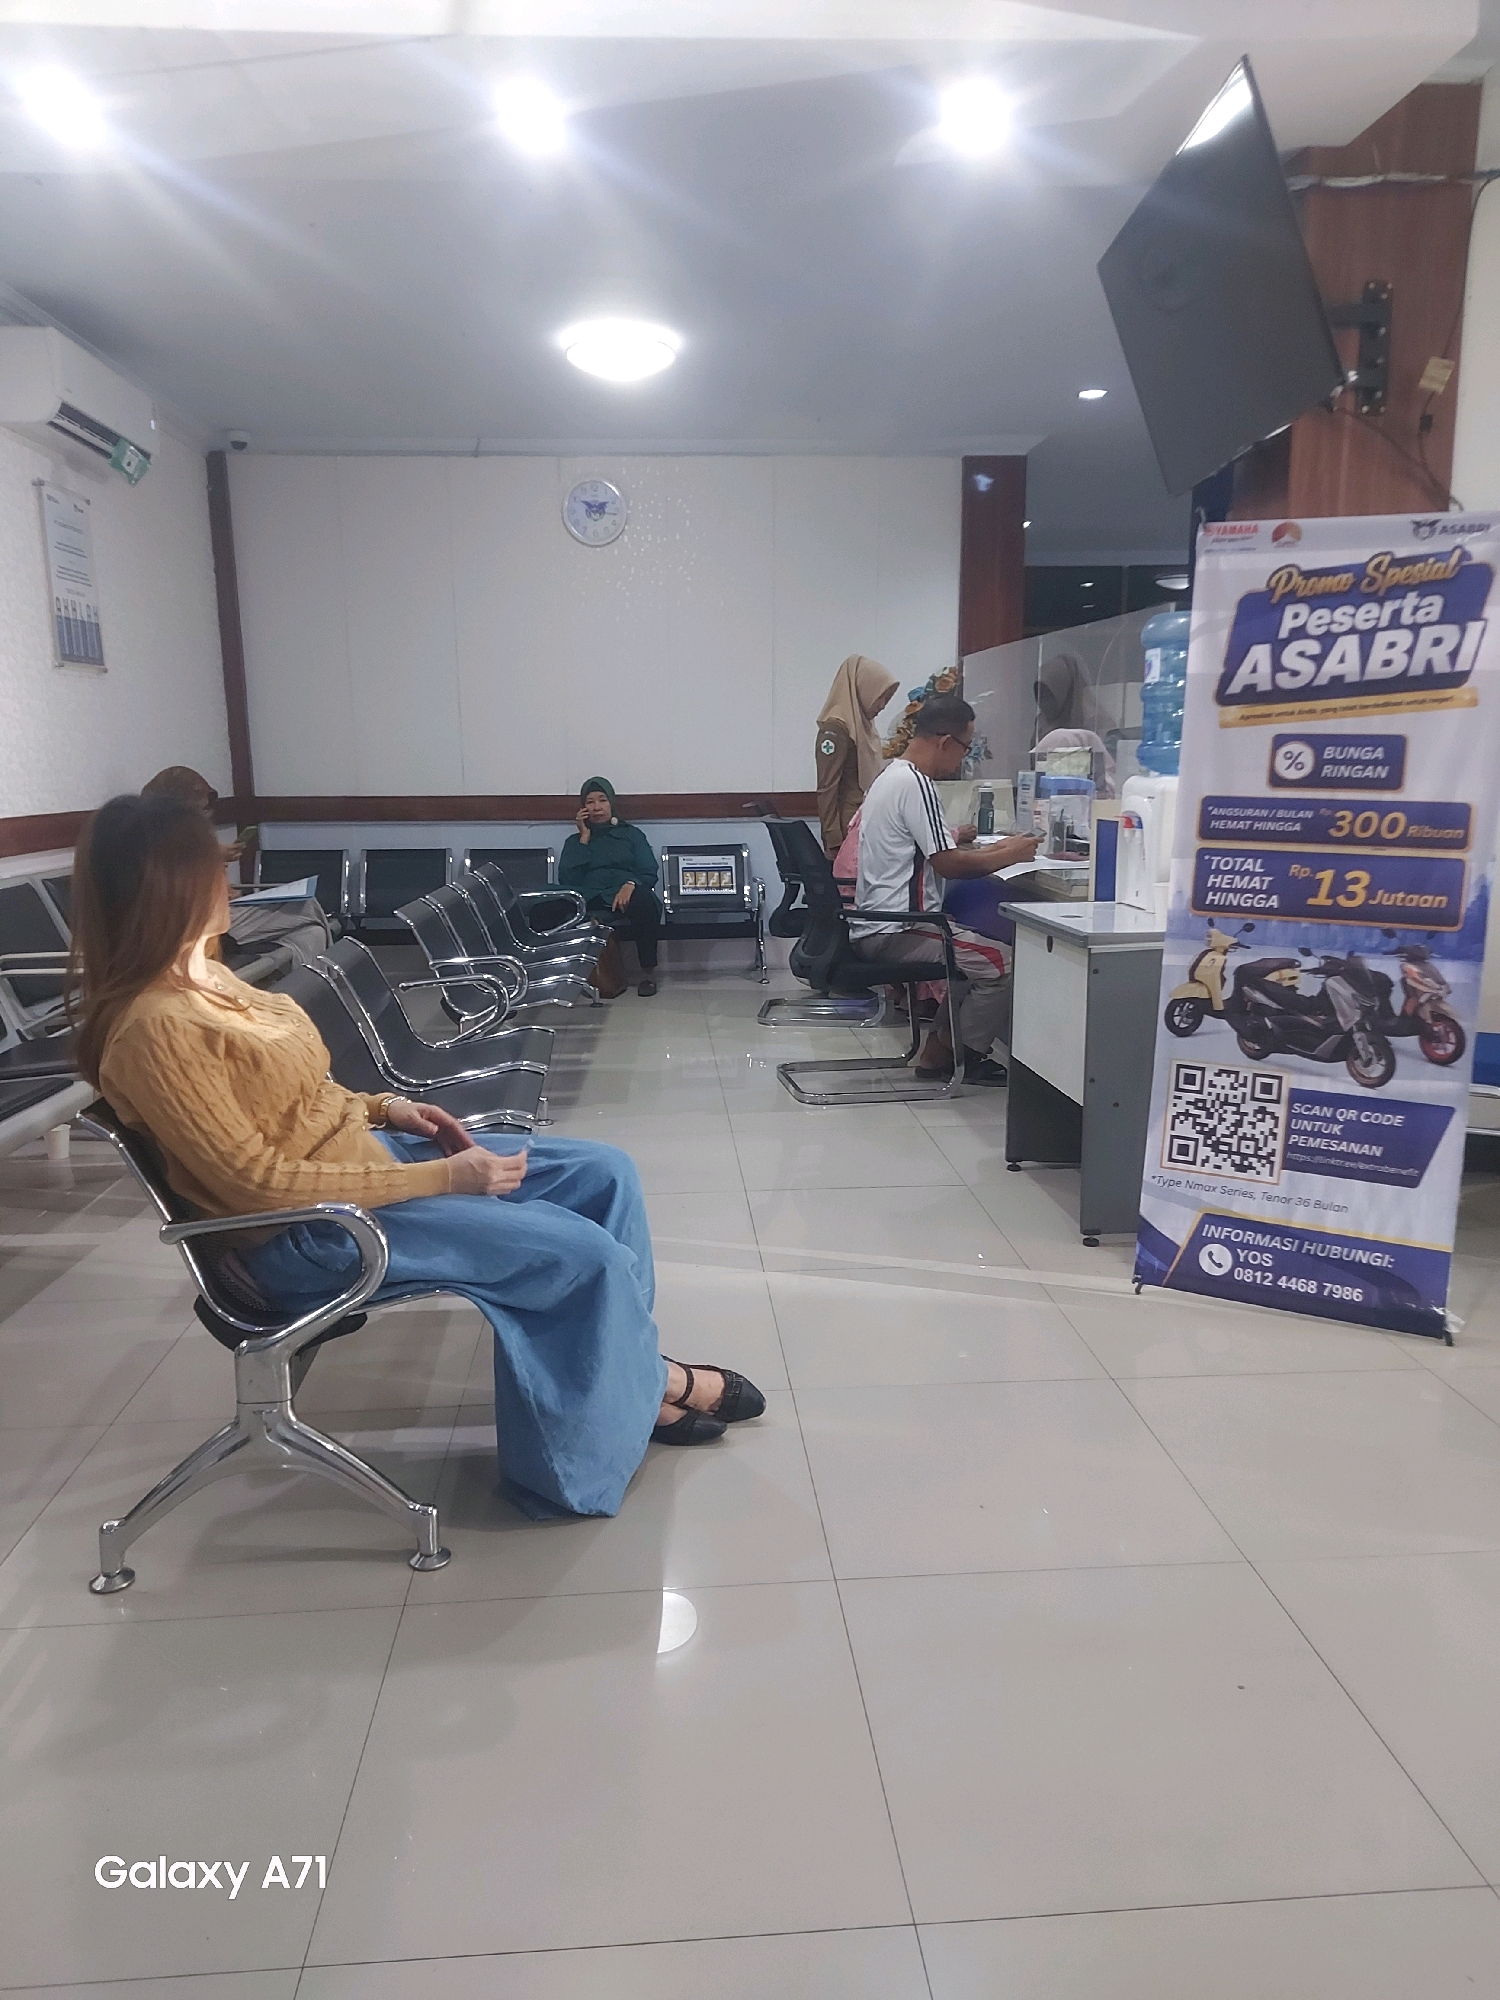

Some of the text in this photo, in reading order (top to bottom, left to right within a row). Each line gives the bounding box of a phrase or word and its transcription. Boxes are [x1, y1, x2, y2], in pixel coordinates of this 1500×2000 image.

[1270, 566, 1355, 604] Promo
[1277, 591, 1445, 640] Peserta
[1224, 619, 1487, 695] ASABRI
[1322, 746, 1385, 761] BUNGA
[1320, 764, 1389, 779] RINGAN
[1209, 820, 1302, 832] HEMAT HINGGA
[1276, 809, 1315, 819] BULAN
[1329, 810, 1407, 840] 300
[1406, 825, 1465, 839] Ribuan
[1206, 874, 1275, 891] HEMAT
[1306, 868, 1371, 908] 13
[1368, 890, 1448, 909] Jutaan
[1204, 891, 1280, 909] HINGGA
[1290, 1118, 1344, 1136] UNTUK
[1291, 1102, 1405, 1127] SCAN QR CODE
[1287, 1134, 1384, 1158] PEMESANAN
[1184, 1180, 1217, 1193] Nmax
[1220, 1185, 1256, 1200] Series,
[1260, 1191, 1294, 1205] Tenor
[1294, 1197, 1311, 1208] 36
[1313, 1200, 1349, 1214] Bulan
[1202, 1224, 1395, 1269] INFORMASI HUBUNGI:
[1236, 1248, 1273, 1267] YOS
[1234, 1267, 1364, 1302] 0812 4468 7986
